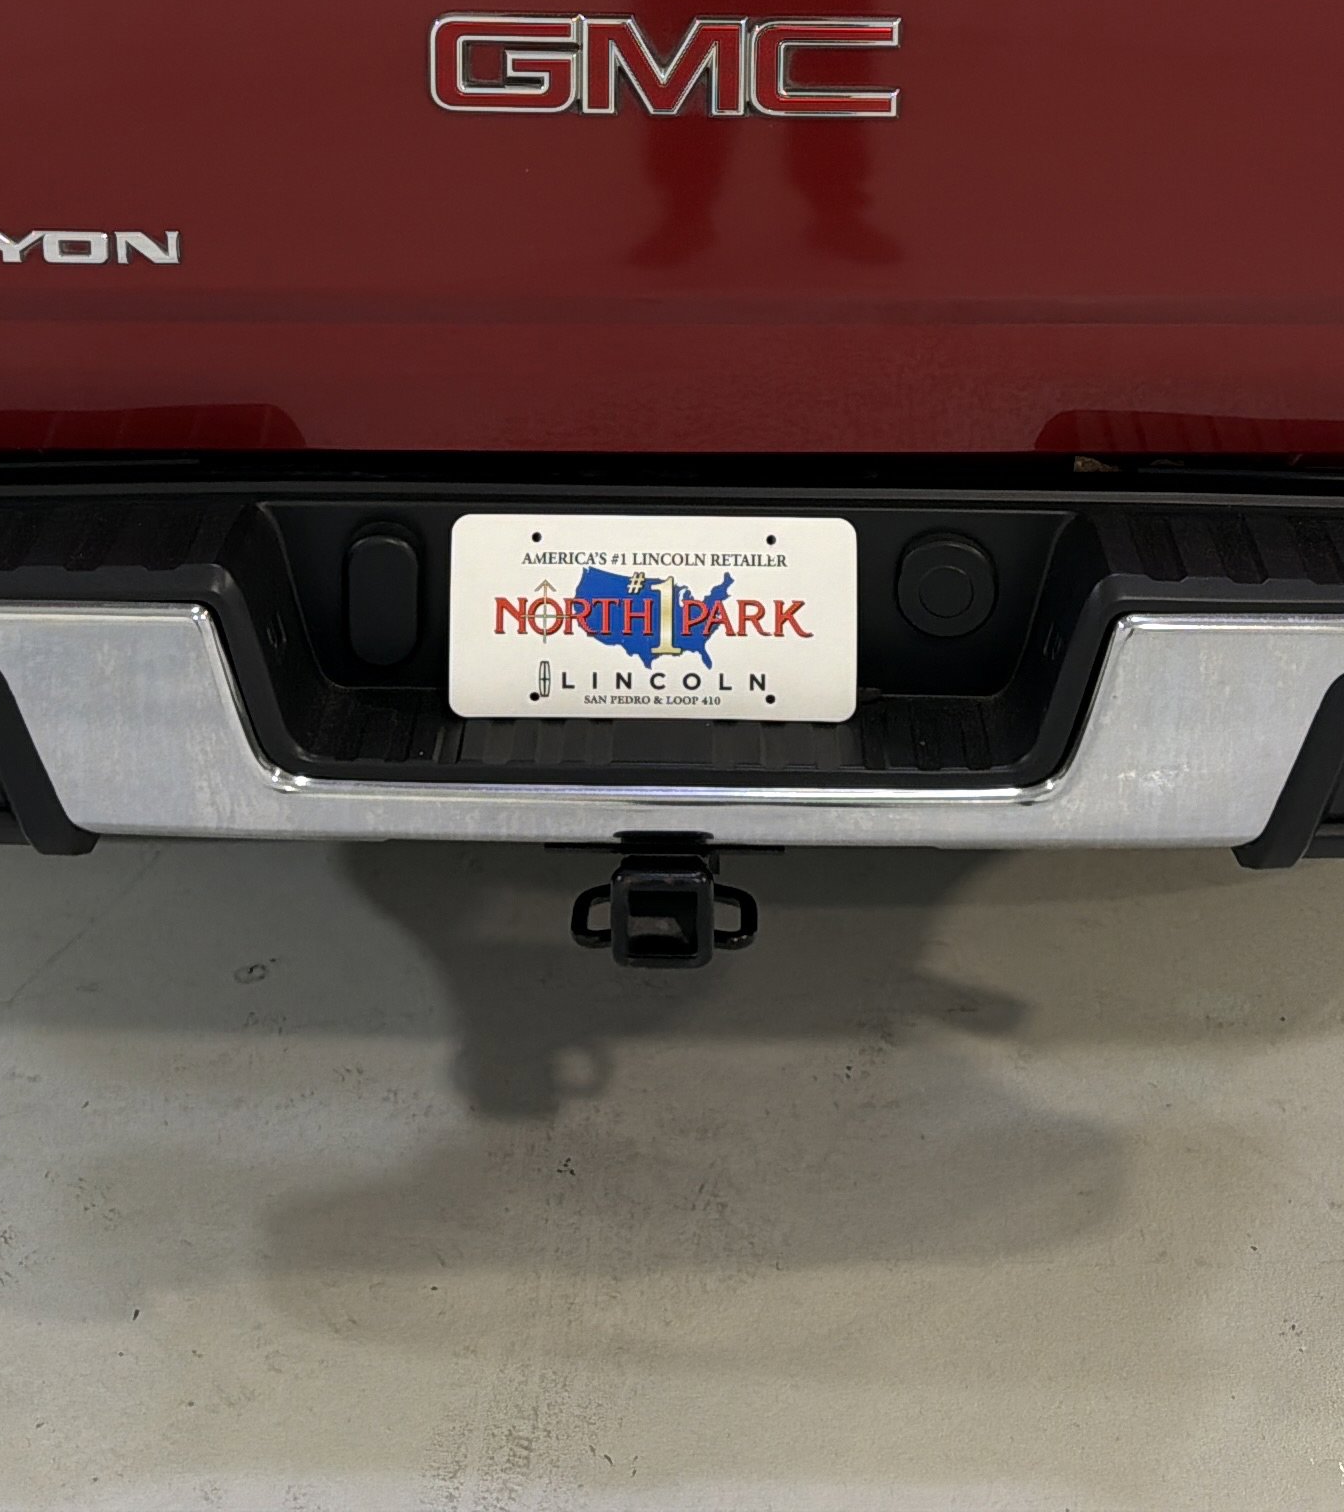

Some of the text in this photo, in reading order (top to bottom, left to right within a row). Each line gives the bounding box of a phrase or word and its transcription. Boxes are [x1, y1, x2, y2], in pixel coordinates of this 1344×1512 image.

[430, 12, 902, 117] GMC
[521, 551, 788, 567] AMERICA'S #1 LINCOLN RETAILER
[494, 596, 814, 638] NORTH PARK
[561, 671, 766, 691] LINCOLN
[584, 694, 721, 706] SAN PEDRO & LOOP 410
